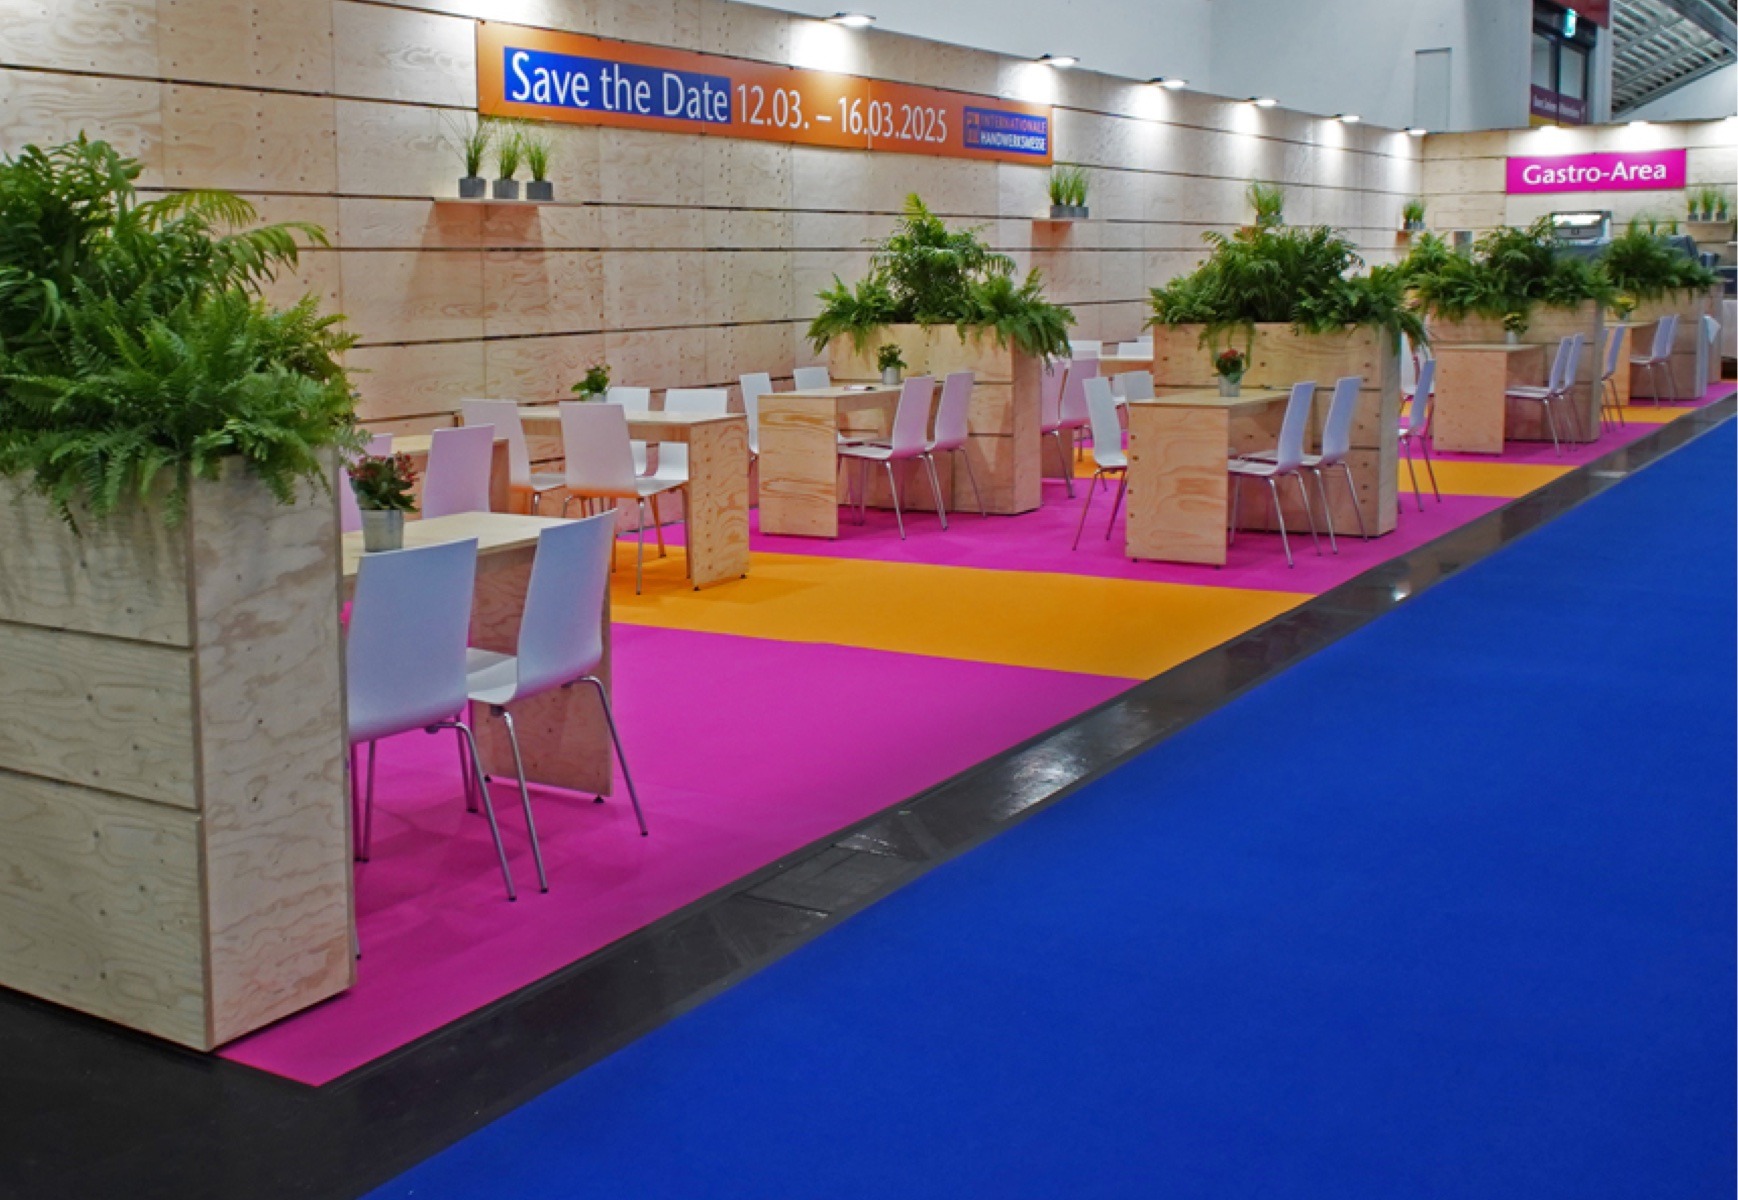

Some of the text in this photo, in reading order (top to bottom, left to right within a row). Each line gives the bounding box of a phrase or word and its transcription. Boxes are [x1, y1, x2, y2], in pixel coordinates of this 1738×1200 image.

[512, 51, 589, 107] Save
[600, 63, 651, 113] the
[662, 72, 728, 122] Date
[737, 83, 809, 130] 12.03.
[838, 96, 947, 143] 16.03.2025
[1522, 161, 1667, 185] Gastro-Area
